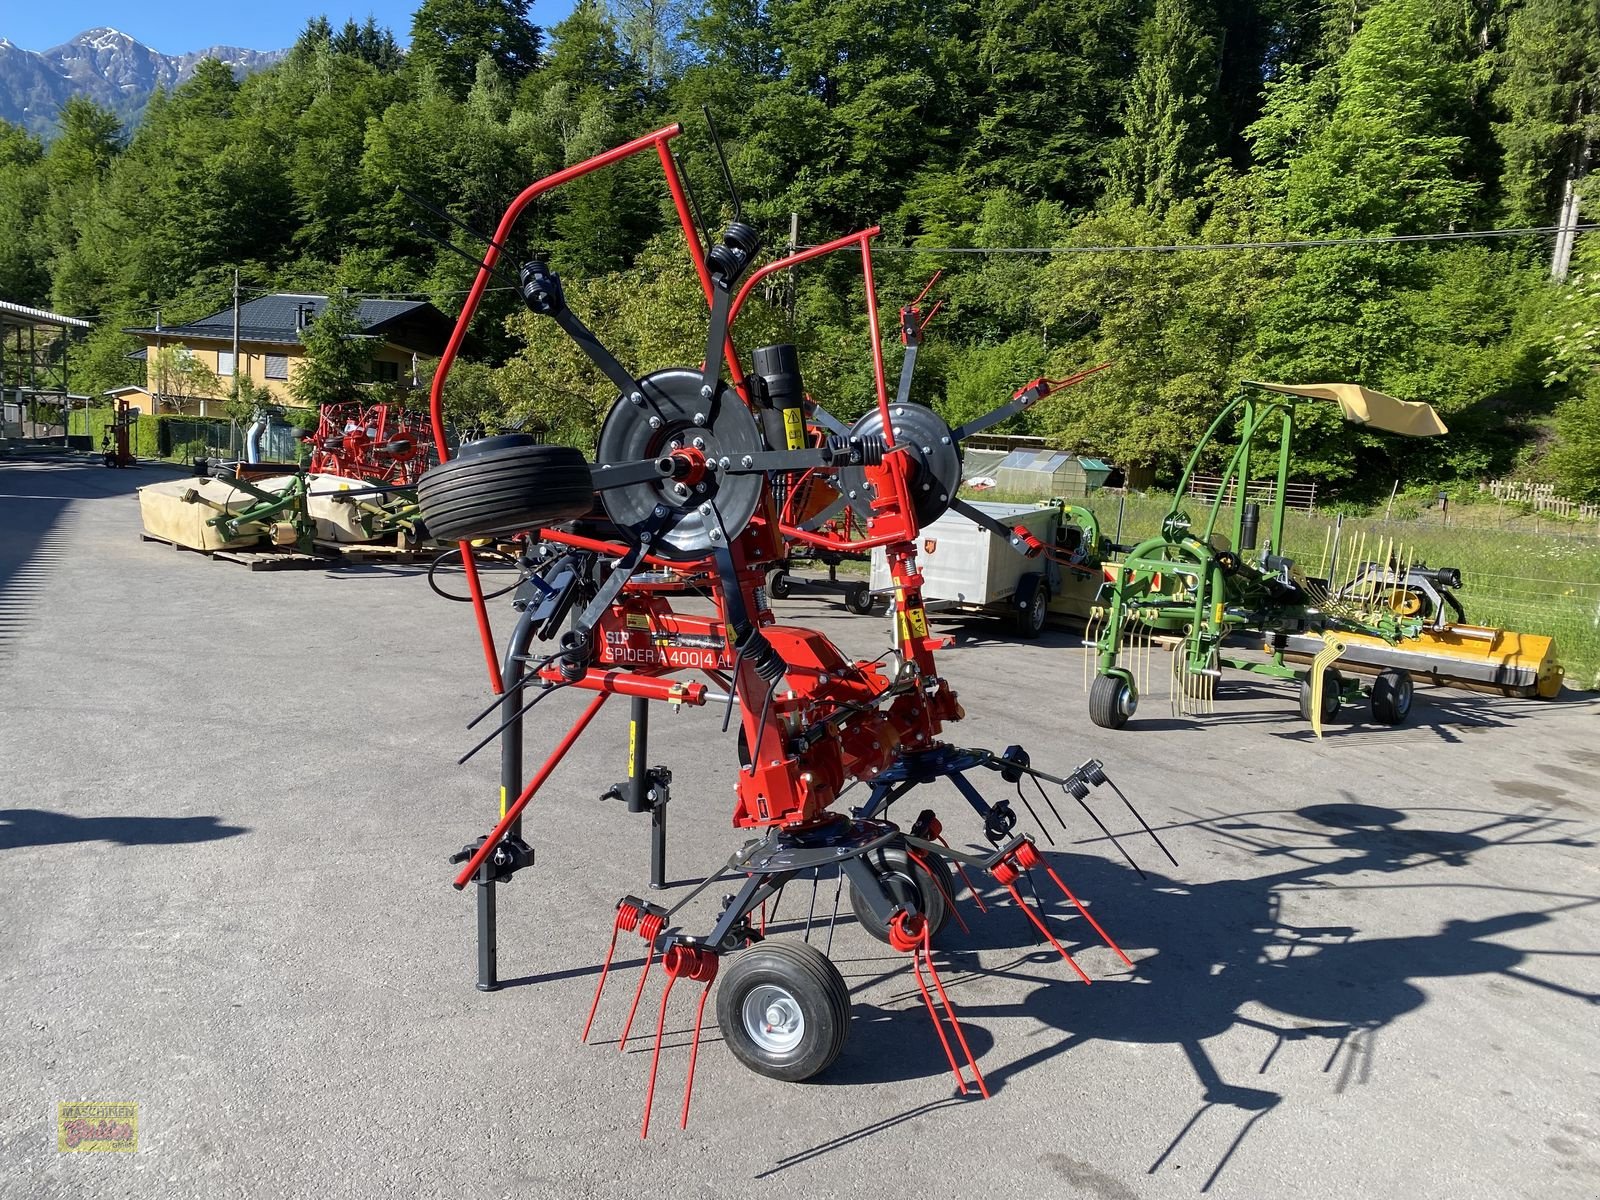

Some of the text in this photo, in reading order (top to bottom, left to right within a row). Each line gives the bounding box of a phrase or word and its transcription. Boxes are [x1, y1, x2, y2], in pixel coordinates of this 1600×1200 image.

[605, 631, 630, 645] SIP
[605, 647, 654, 663] SPIDER
[657, 650, 667, 664] A
